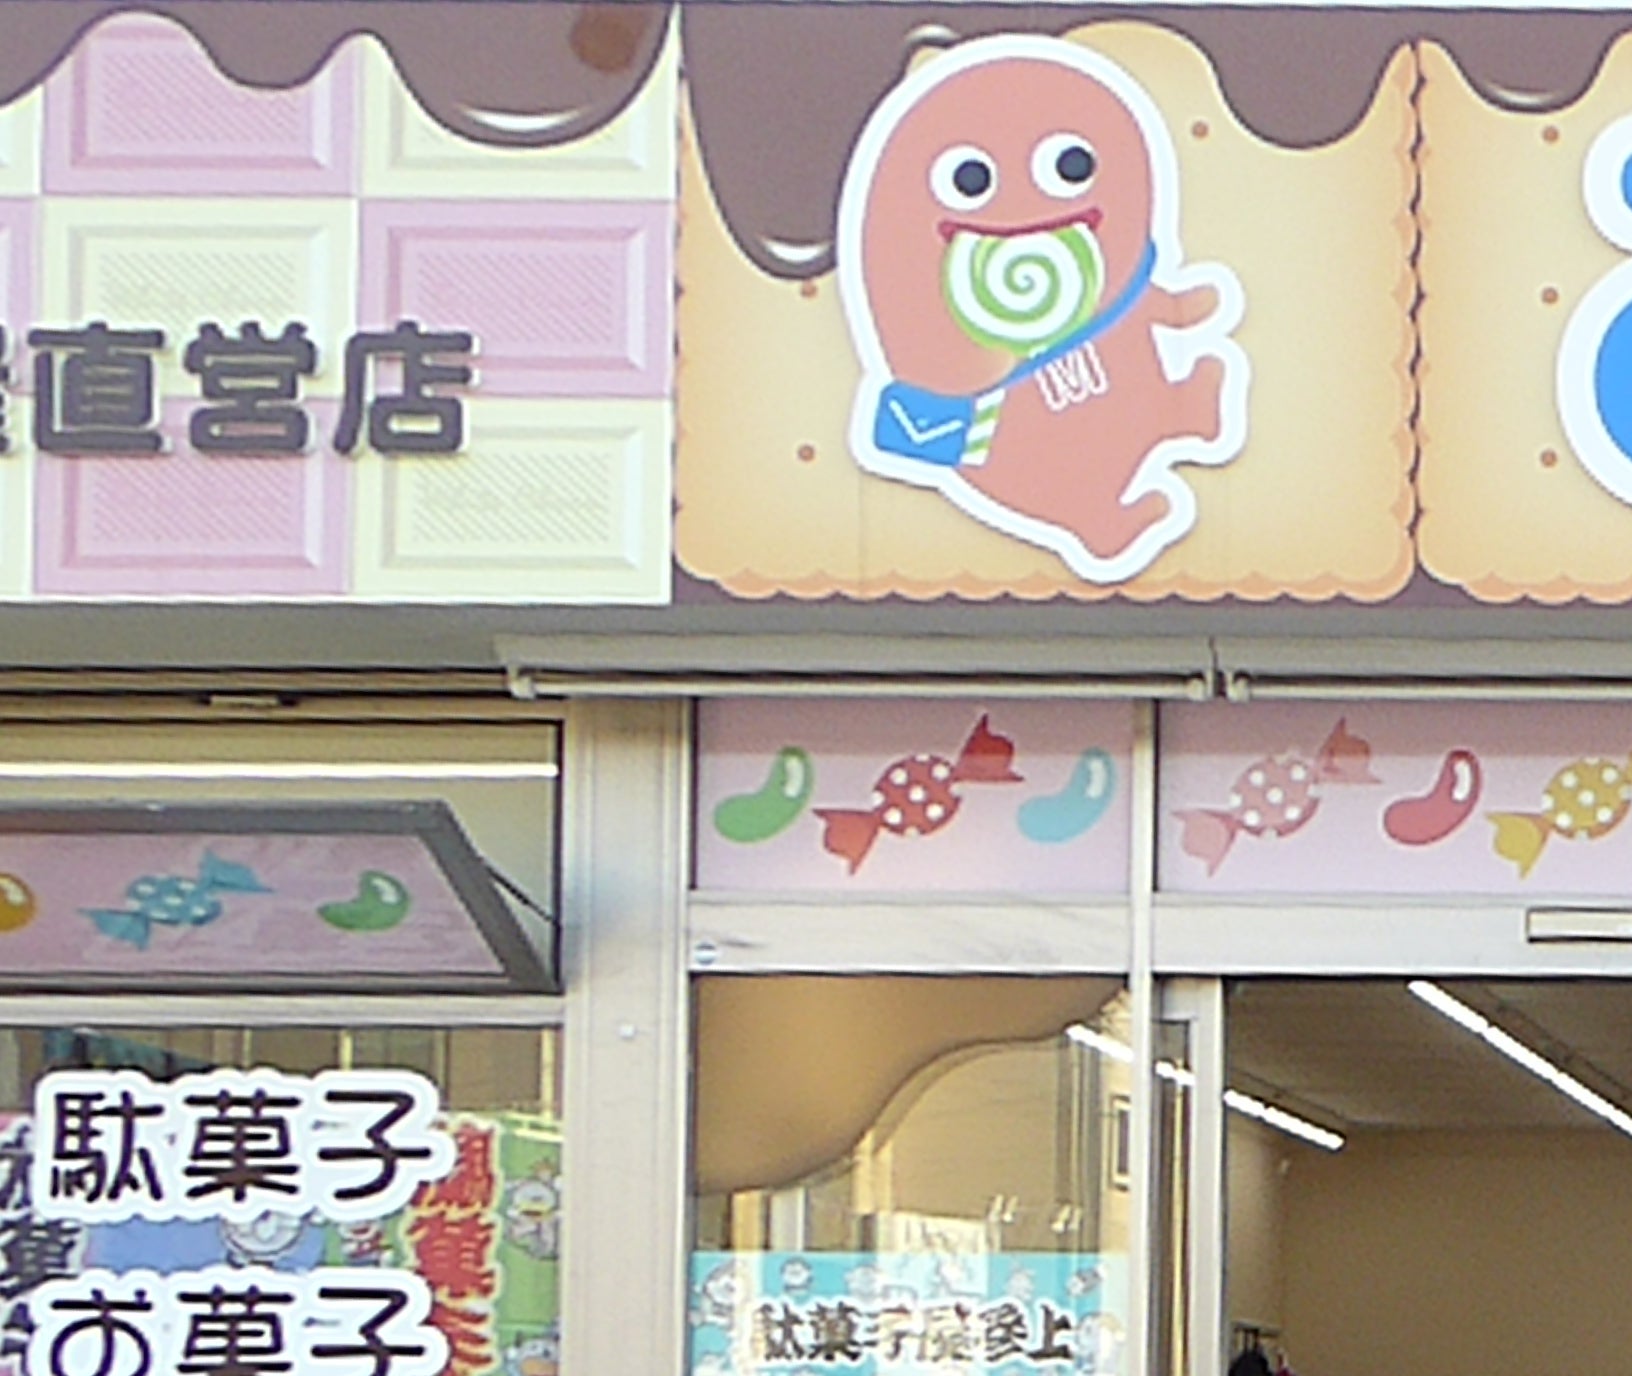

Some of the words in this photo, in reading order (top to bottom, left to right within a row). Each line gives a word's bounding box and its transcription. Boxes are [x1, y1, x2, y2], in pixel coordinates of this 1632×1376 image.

[0, 321, 472, 454] 直営店
[50, 1089, 431, 1201] 駄菓子
[754, 1302, 1075, 1361] 駄菓子屋参上
